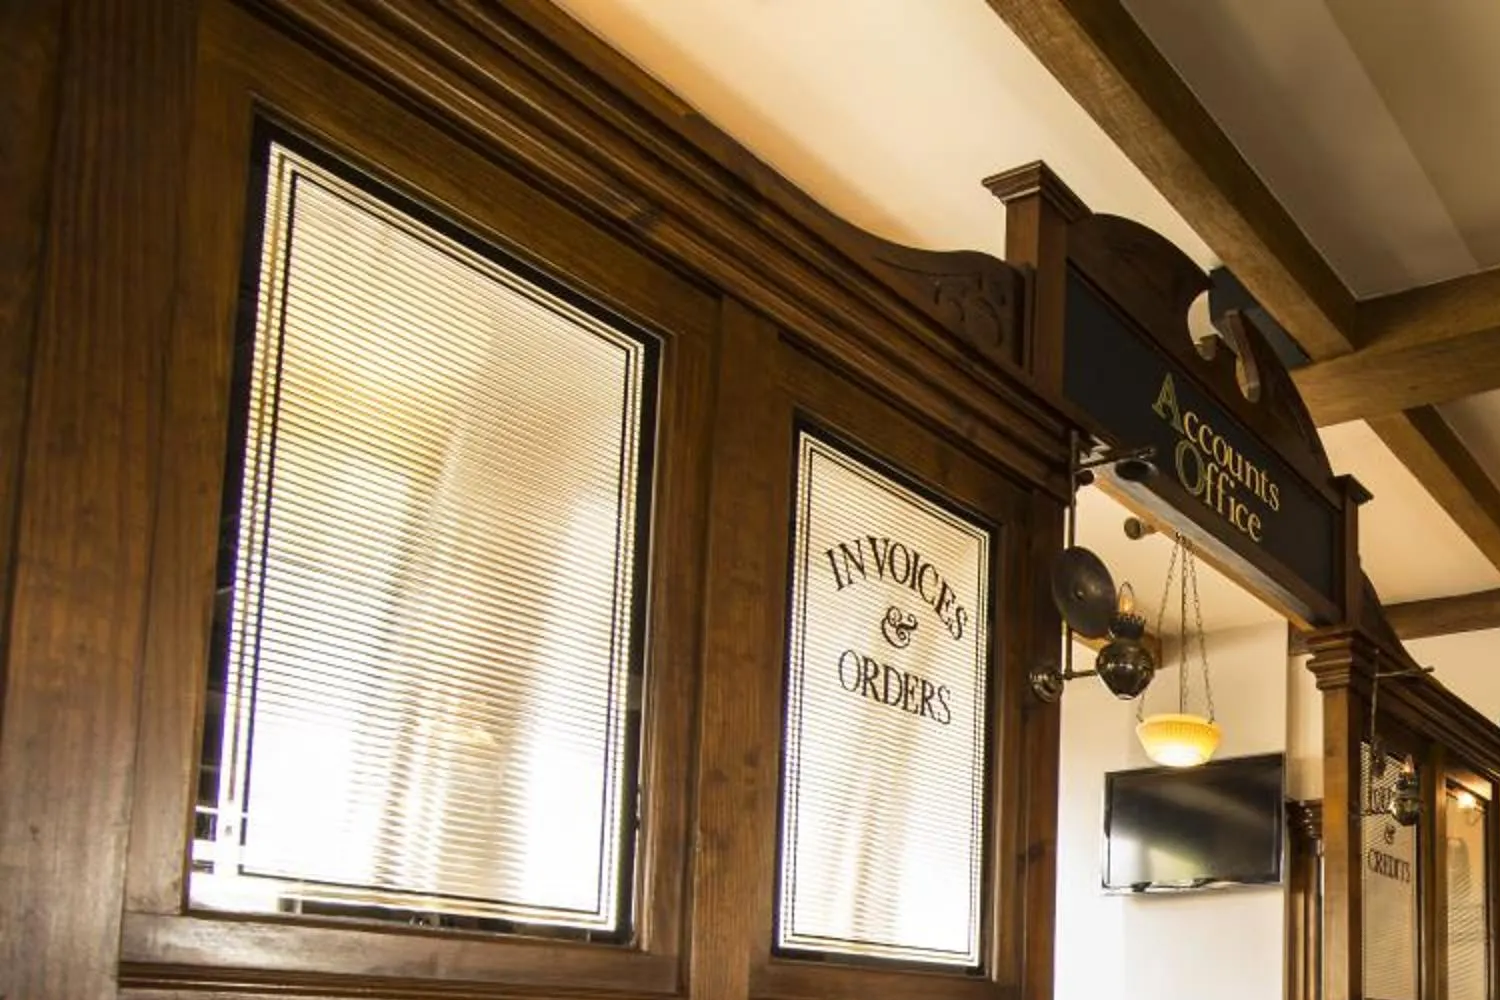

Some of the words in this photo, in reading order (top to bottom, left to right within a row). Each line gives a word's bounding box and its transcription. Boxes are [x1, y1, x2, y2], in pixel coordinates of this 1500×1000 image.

[1152, 373, 1279, 511] Accounts
[1175, 439, 1262, 542] Office
[824, 534, 968, 641] INVOICES
[881, 605, 918, 648] &
[838, 649, 951, 725] ORDERS
